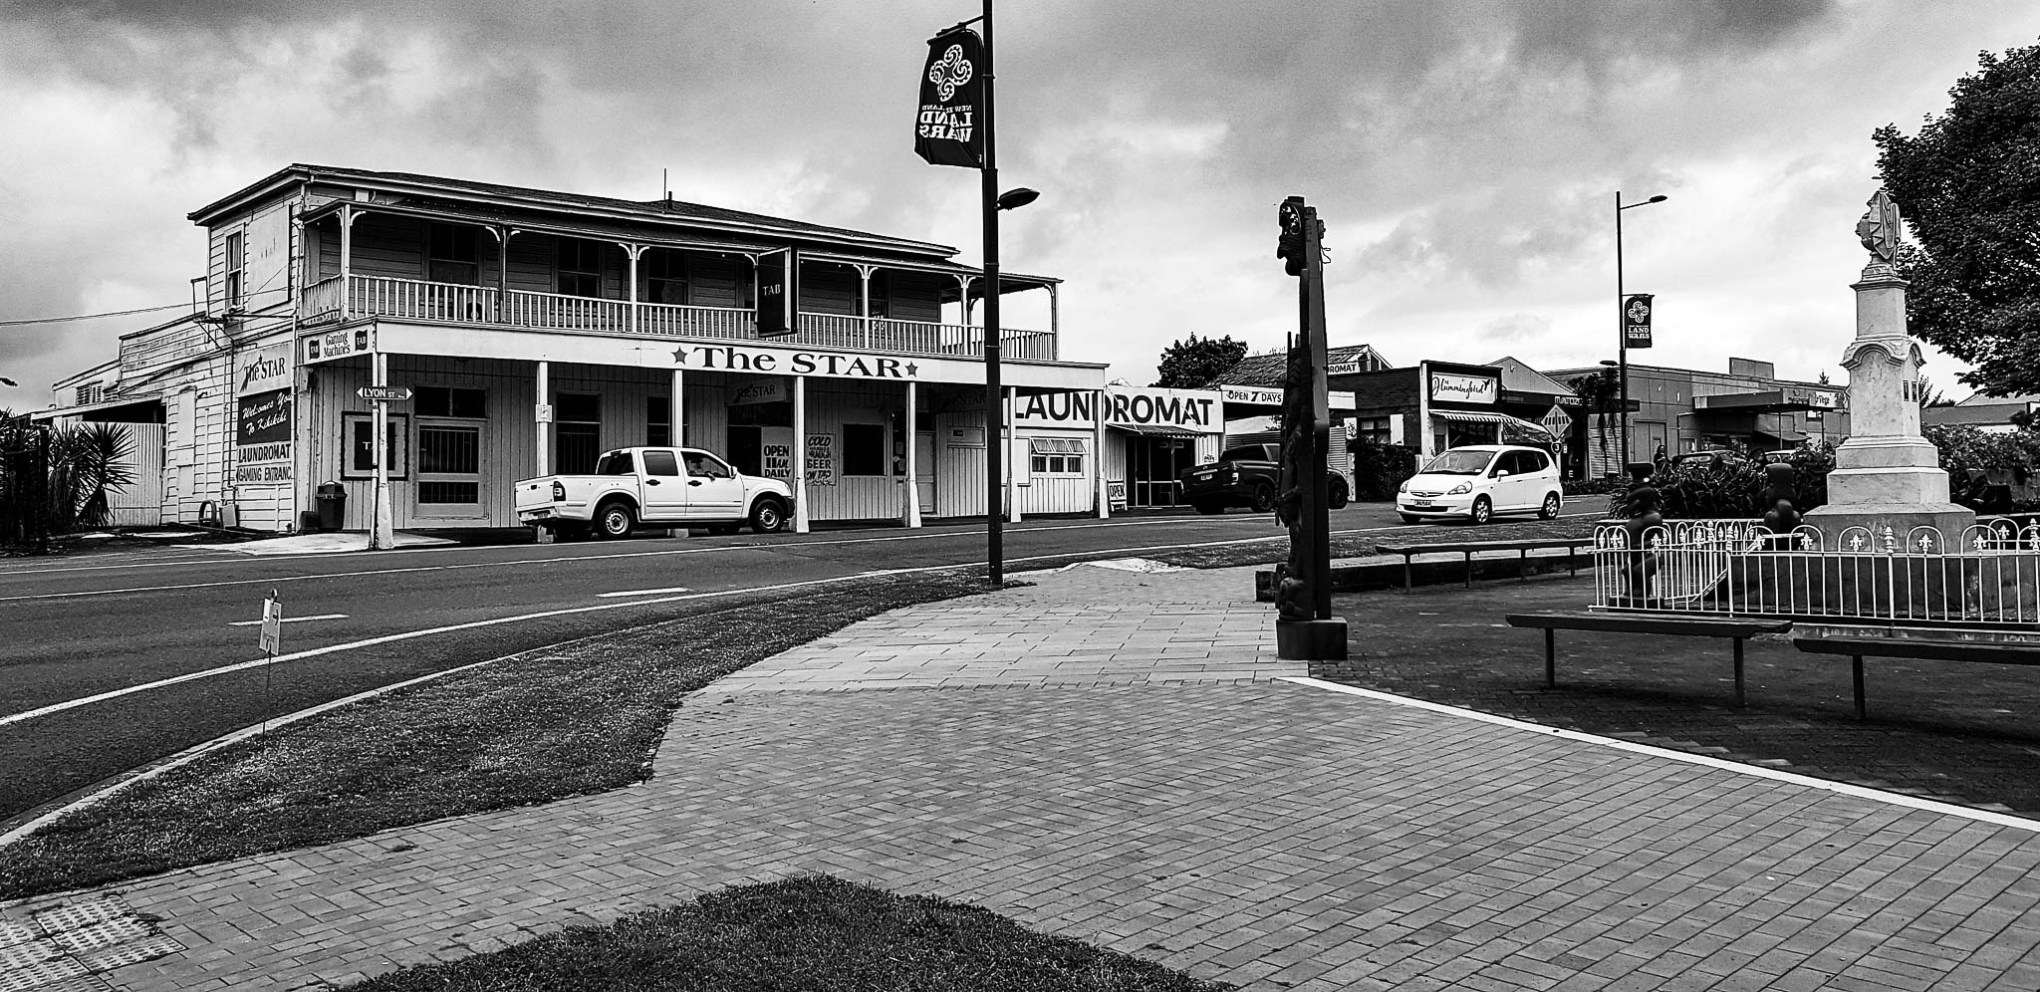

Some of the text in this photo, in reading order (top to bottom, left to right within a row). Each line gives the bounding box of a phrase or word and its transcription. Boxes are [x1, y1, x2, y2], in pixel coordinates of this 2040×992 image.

[762, 284, 781, 296] TAB
[325, 331, 349, 346] Gaming
[356, 336, 367, 345] TAB
[310, 345, 319, 354] TAB
[323, 343, 351, 358] Machines
[693, 346, 903, 378] The STAR
[244, 357, 286, 383] The STAR
[364, 388, 386, 397] LYON
[752, 384, 776, 398] STAR
[1226, 390, 1282, 403] OPEN 7 DAYS
[242, 400, 274, 420] Welcomes
[245, 421, 255, 436] To
[808, 435, 832, 447] COLD
[238, 444, 291, 463] LAUNDROMAT
[763, 444, 790, 457] OPEN
[807, 459, 832, 469] BEER
[239, 464, 291, 482] GAMING ENTRANC
[764, 468, 791, 478] DAILY
[1109, 484, 1125, 499] OPEN
